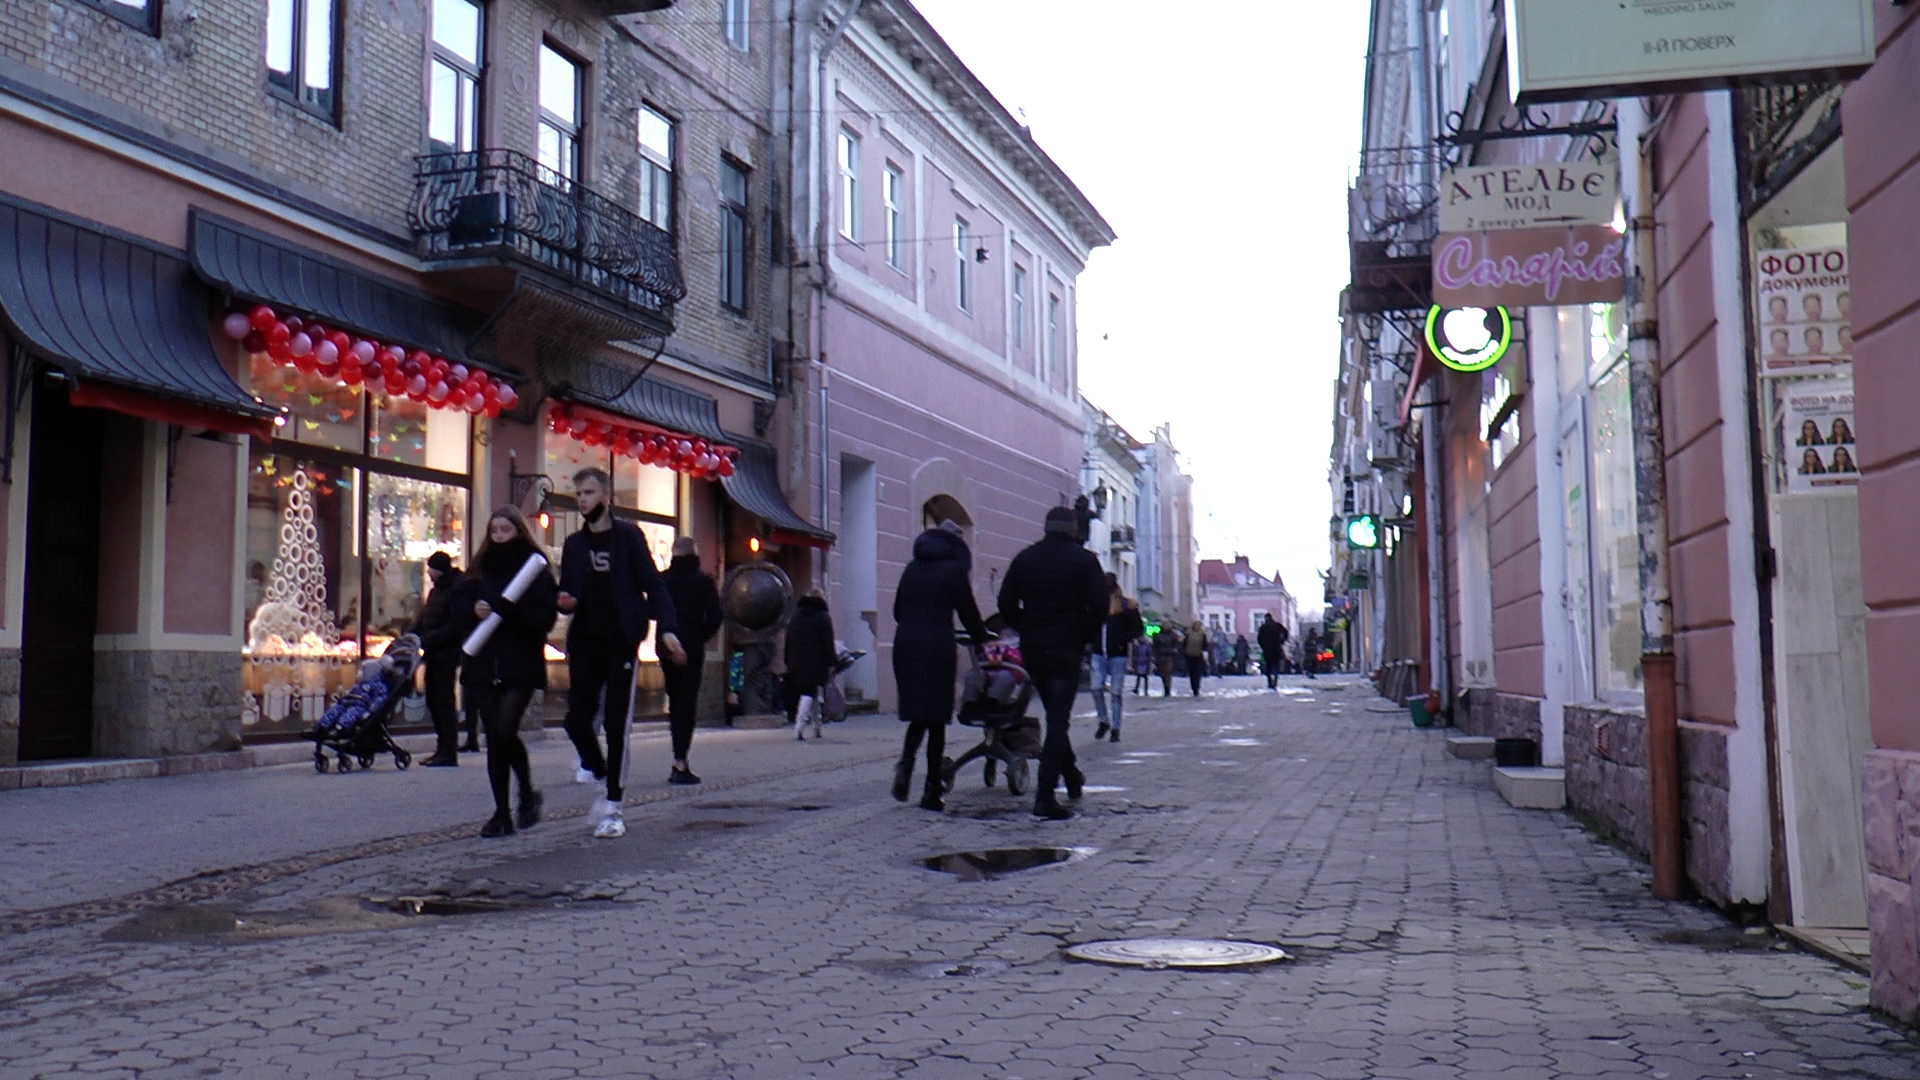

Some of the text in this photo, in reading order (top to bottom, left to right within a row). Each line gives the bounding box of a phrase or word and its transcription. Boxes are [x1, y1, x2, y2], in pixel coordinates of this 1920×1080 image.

[1698, 1, 1737, 11] SALON
[1672, 35, 1737, 51] ПОВЕРХ
[1449, 168, 1605, 206] АТЕЛЬЄ
[1504, 195, 1552, 211] МОД
[1467, 217, 1527, 230] 2 поверх
[1761, 250, 1845, 276] ФОТО
